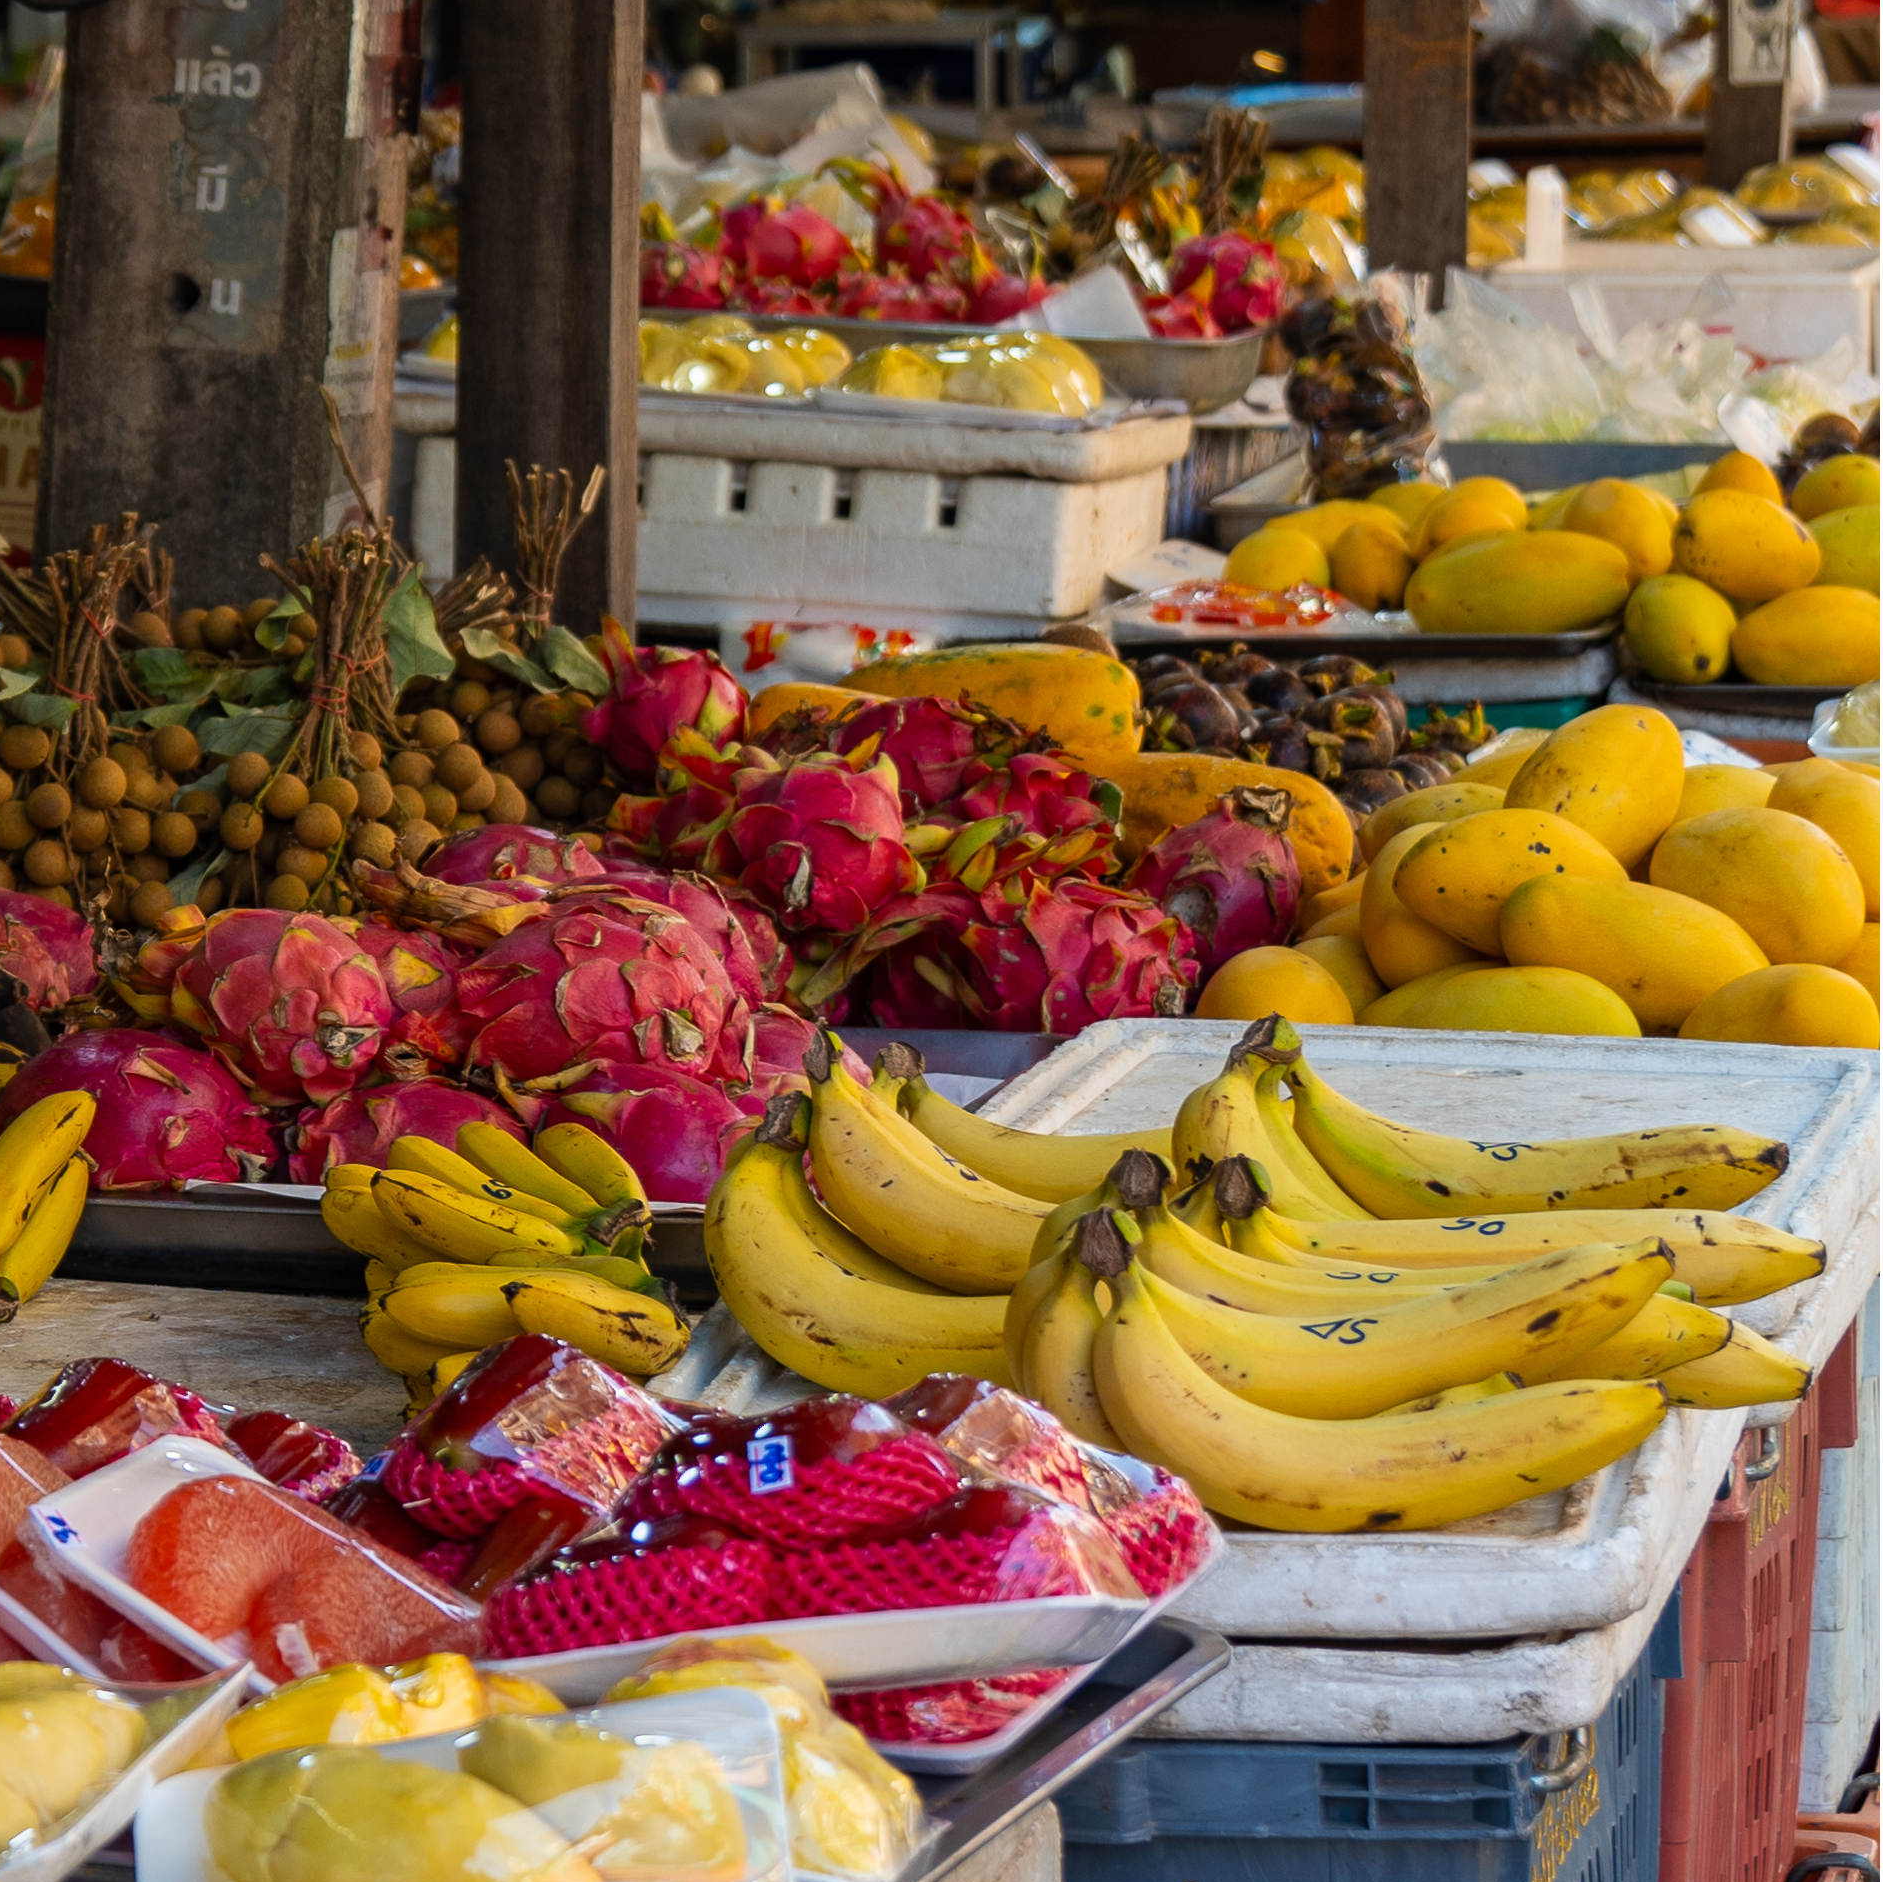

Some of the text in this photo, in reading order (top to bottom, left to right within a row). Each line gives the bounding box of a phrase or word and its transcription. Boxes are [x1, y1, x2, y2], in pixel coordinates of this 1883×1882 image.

[174, 45, 262, 100] แล้ว
[195, 163, 228, 213] มี
[1440, 1215, 1506, 1236] 50
